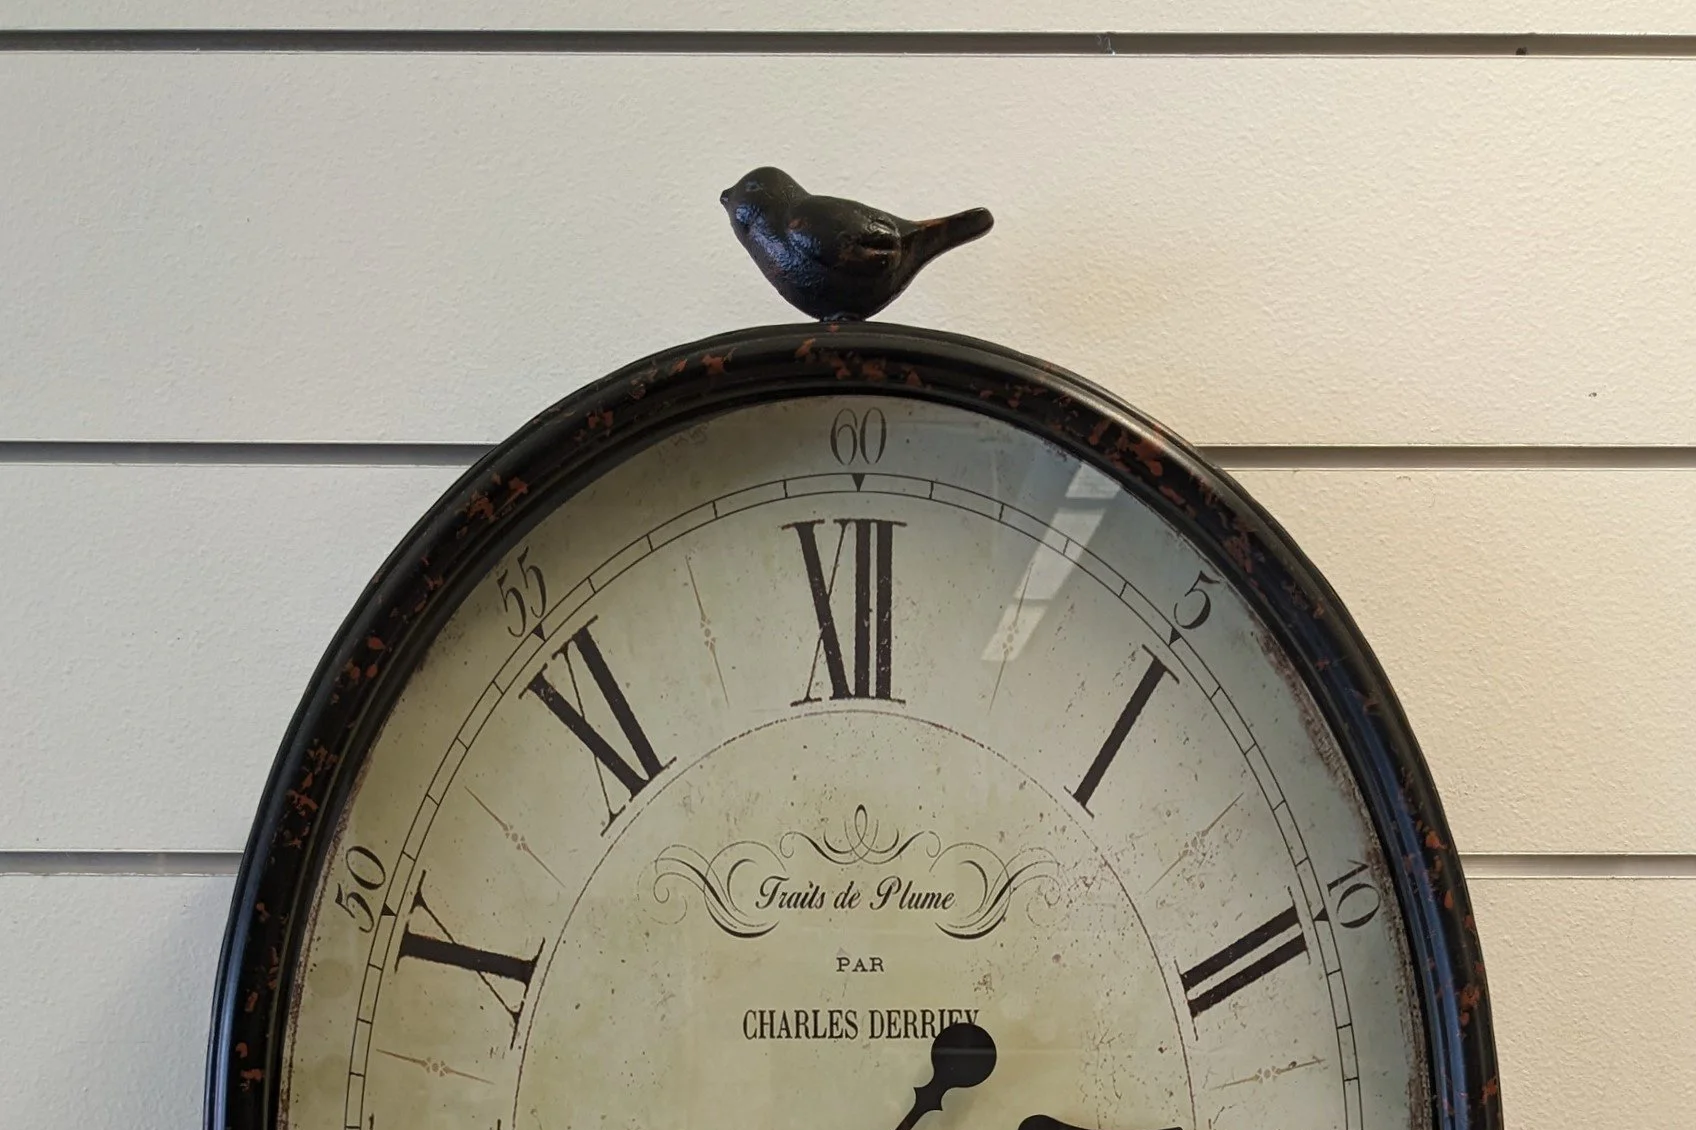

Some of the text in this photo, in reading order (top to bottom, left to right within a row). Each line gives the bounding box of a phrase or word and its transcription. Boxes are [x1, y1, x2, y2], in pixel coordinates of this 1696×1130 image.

[830, 407, 887, 465] 60
[496, 546, 547, 637] 55
[781, 518, 908, 707] XII
[1173, 570, 1221, 630] 5
[519, 615, 677, 837] XI
[334, 846, 386, 933] 50
[755, 875, 955, 911] Traits de Plume
[1326, 859, 1381, 928] 10
[394, 869, 545, 1050] X
[836, 957, 884, 972] PAR
[1174, 886, 1311, 1041] II
[743, 1009, 859, 1040] CHARLES
